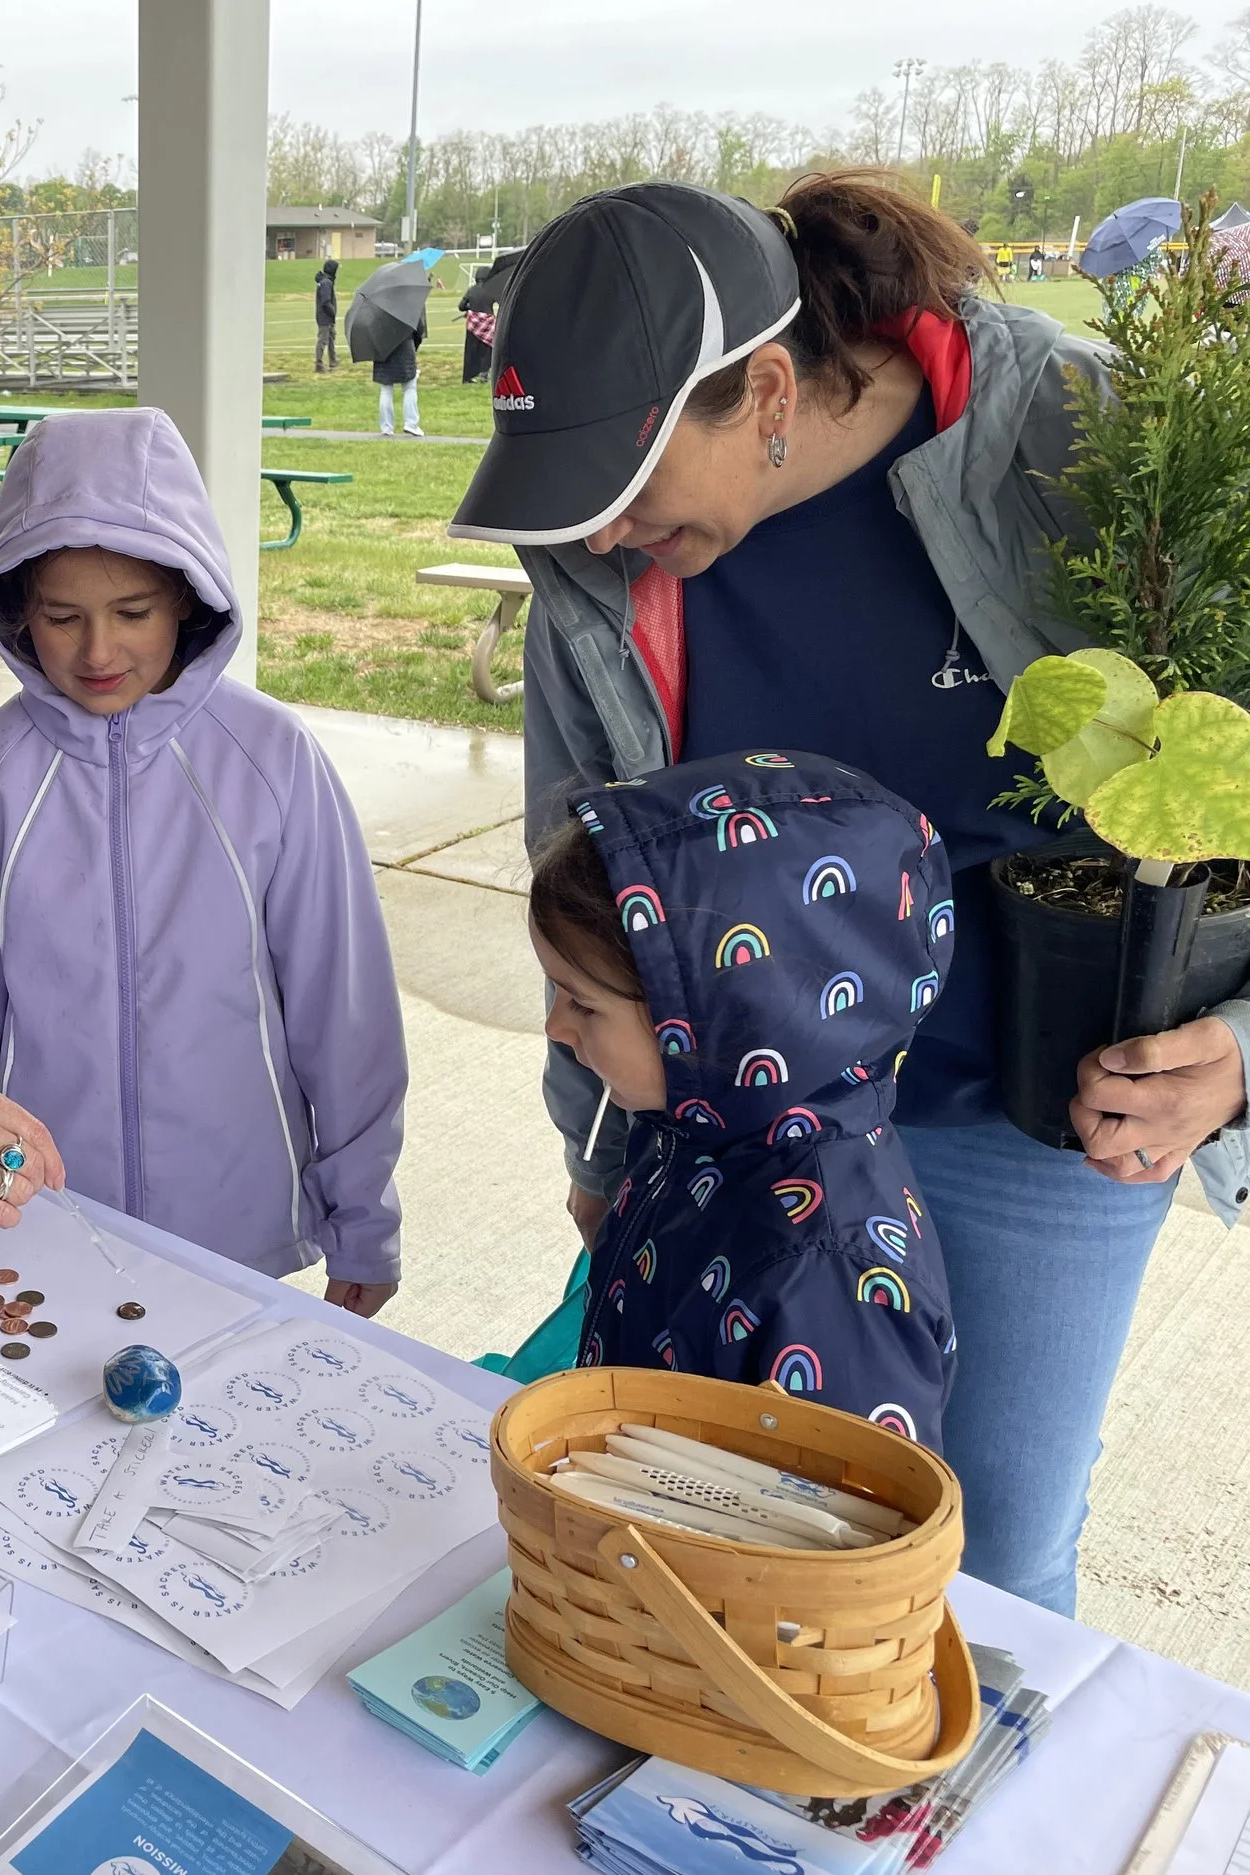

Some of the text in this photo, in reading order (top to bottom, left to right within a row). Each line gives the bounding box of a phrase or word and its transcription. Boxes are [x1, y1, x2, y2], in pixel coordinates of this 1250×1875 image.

[494, 395, 535, 411] adidas
[636, 406, 659, 447] adizero
[287, 1341, 309, 1367] SACRED
[318, 1364, 359, 1378] WATER
[226, 1372, 298, 1412] WATER IS SACRED
[297, 1409, 372, 1451] WATER IS SACRED
[17, 1468, 93, 1517] WATER IS SACRED
[160, 1464, 191, 1486] WATER
[219, 1467, 243, 1495] SACRED
[88, 1507, 117, 1541] TAKE
[159, 1563, 244, 1617] WATER IS SACRED
[438, 1652, 459, 1666] Rivers
[460, 1657, 506, 1685] and Wetlands
[485, 1678, 499, 1689] Our
[131, 1832, 189, 1875] MISSION
